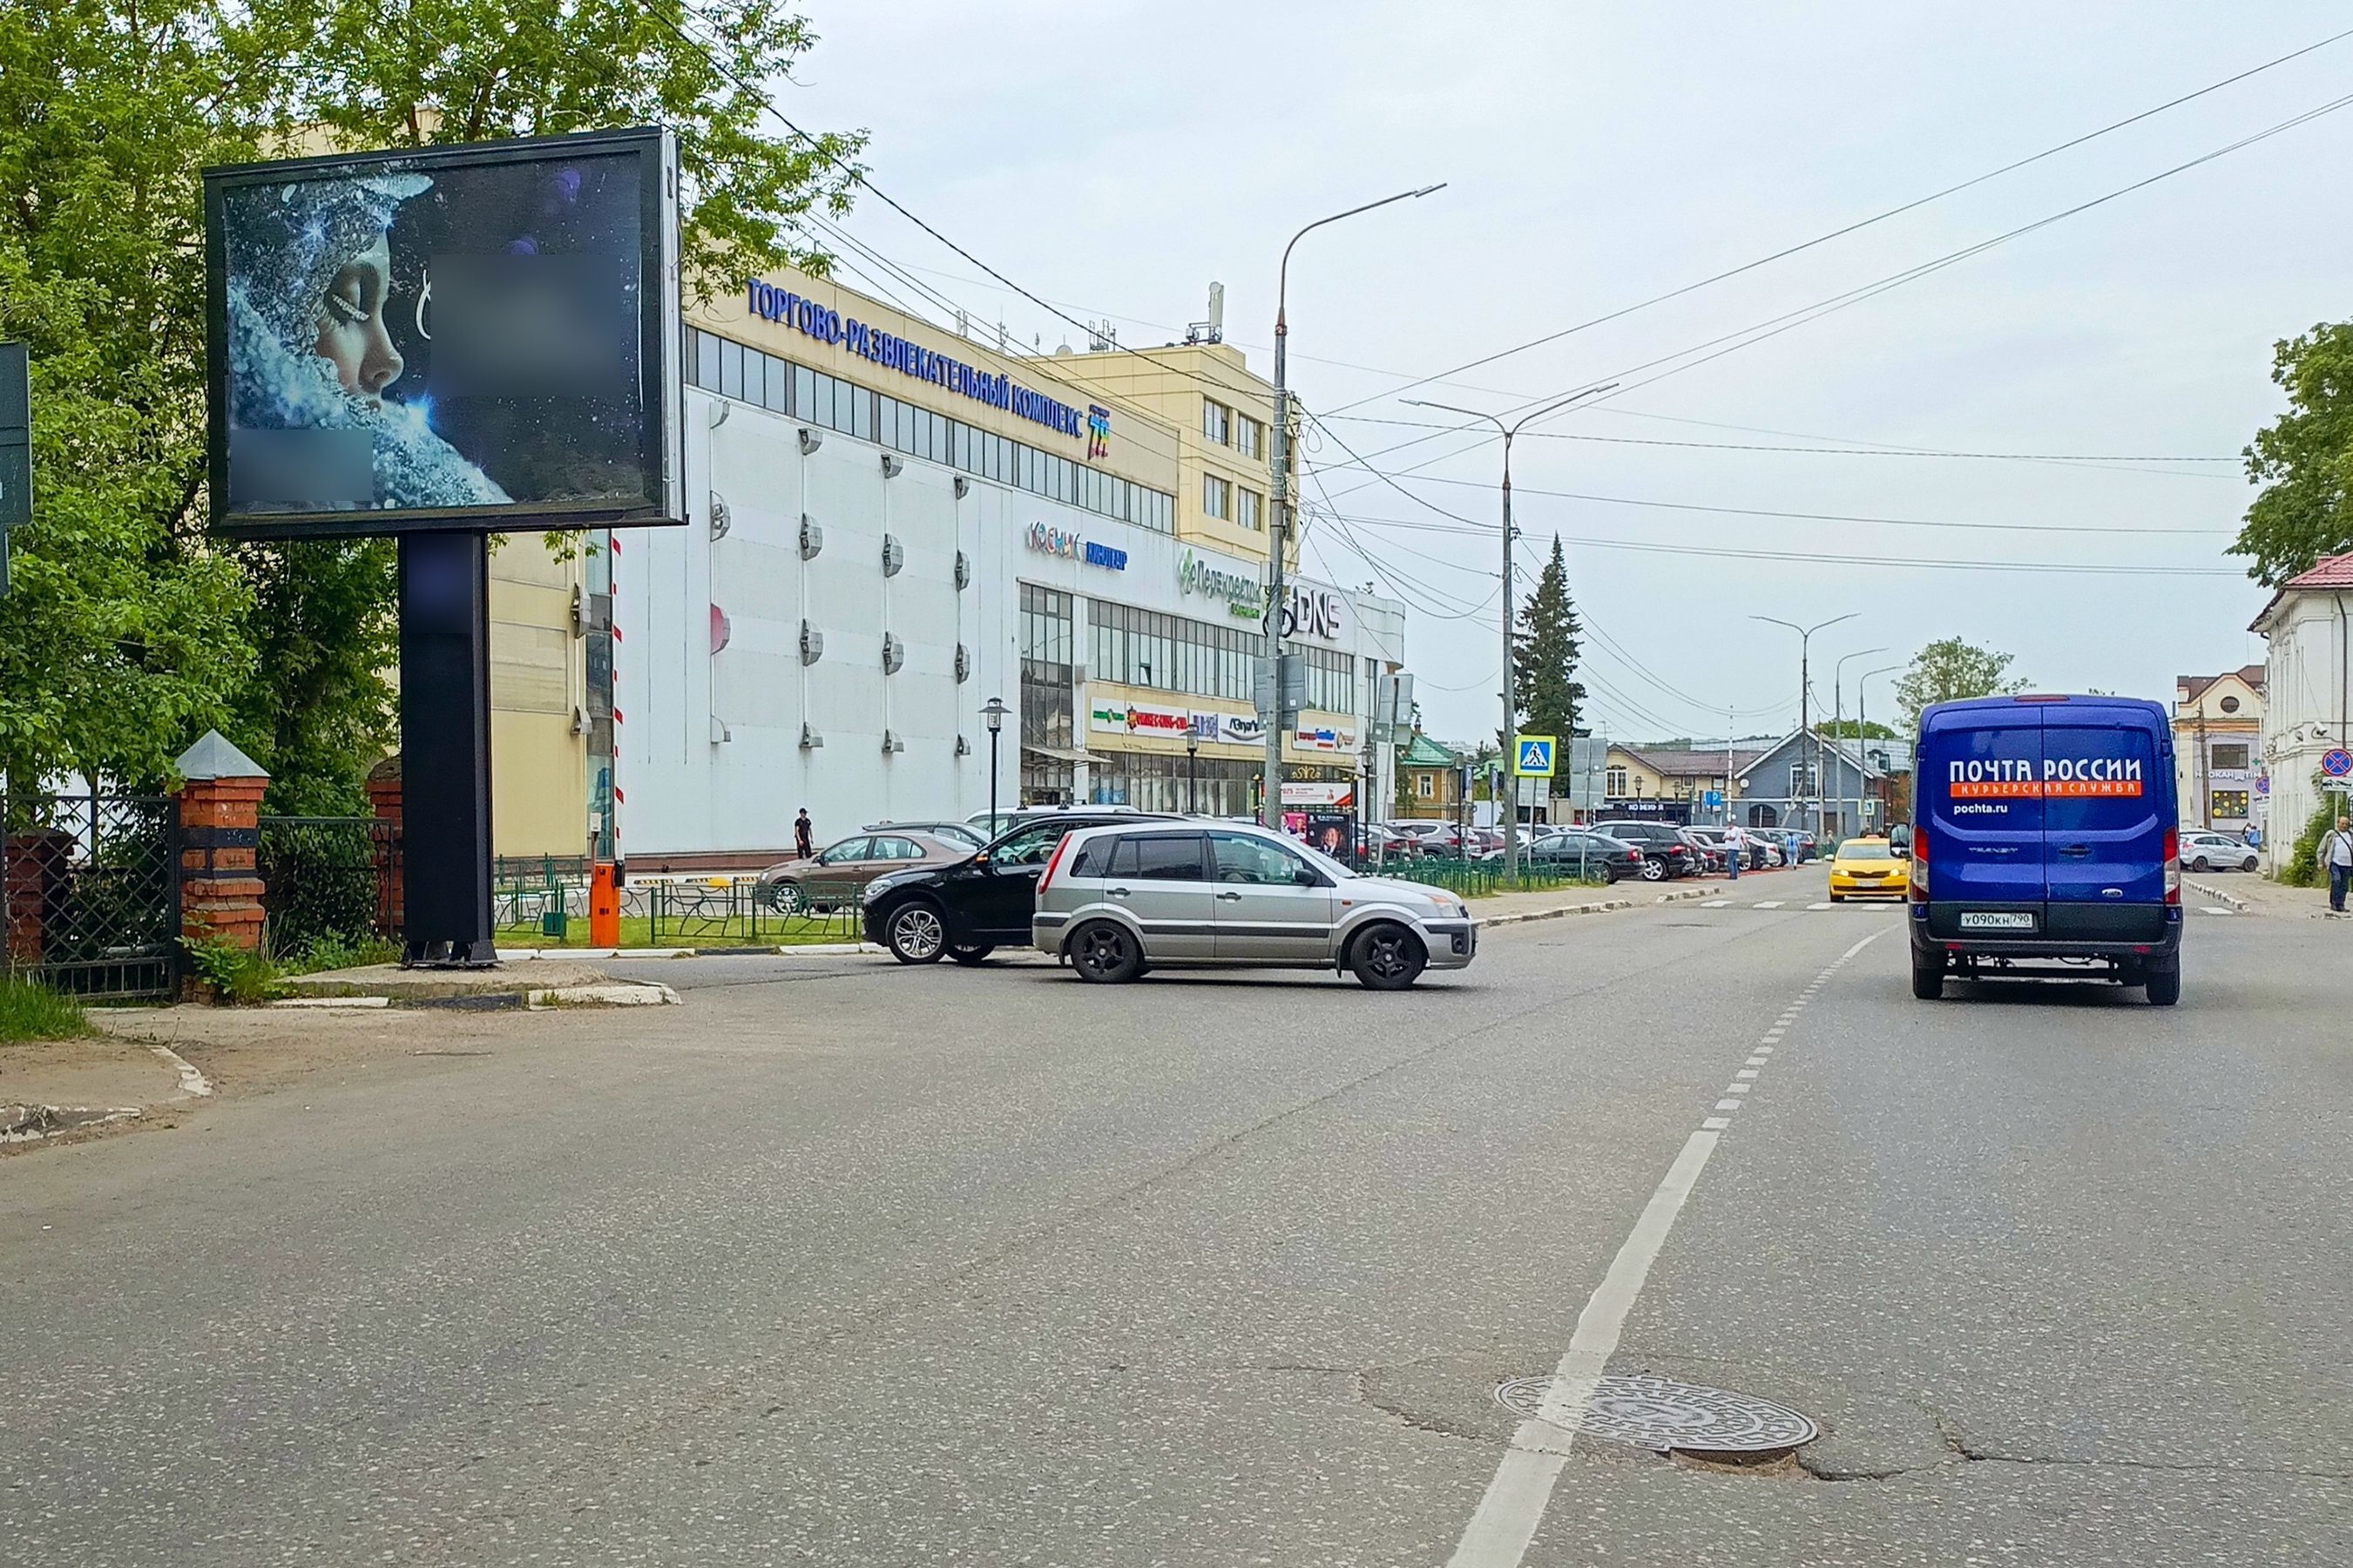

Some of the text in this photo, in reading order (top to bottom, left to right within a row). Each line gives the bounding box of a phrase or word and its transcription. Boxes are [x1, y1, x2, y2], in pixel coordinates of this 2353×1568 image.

[748, 278, 1083, 438] ТОРГОВО-РАЗВЛЕКАТЕЛЬНЫЙ КОМПЛЕКС
[1295, 585, 1342, 639] DNS
[1950, 759, 2141, 782] ПОЧТА РОССИИ
[2194, 771, 2235, 780] HOKAH
[1962, 783, 2135, 794] КУРЬЕРСКАЯ СЛУЖБА
[1954, 803, 2008, 814] pochta.ru
[1965, 914, 2030, 925] У090КН 790
